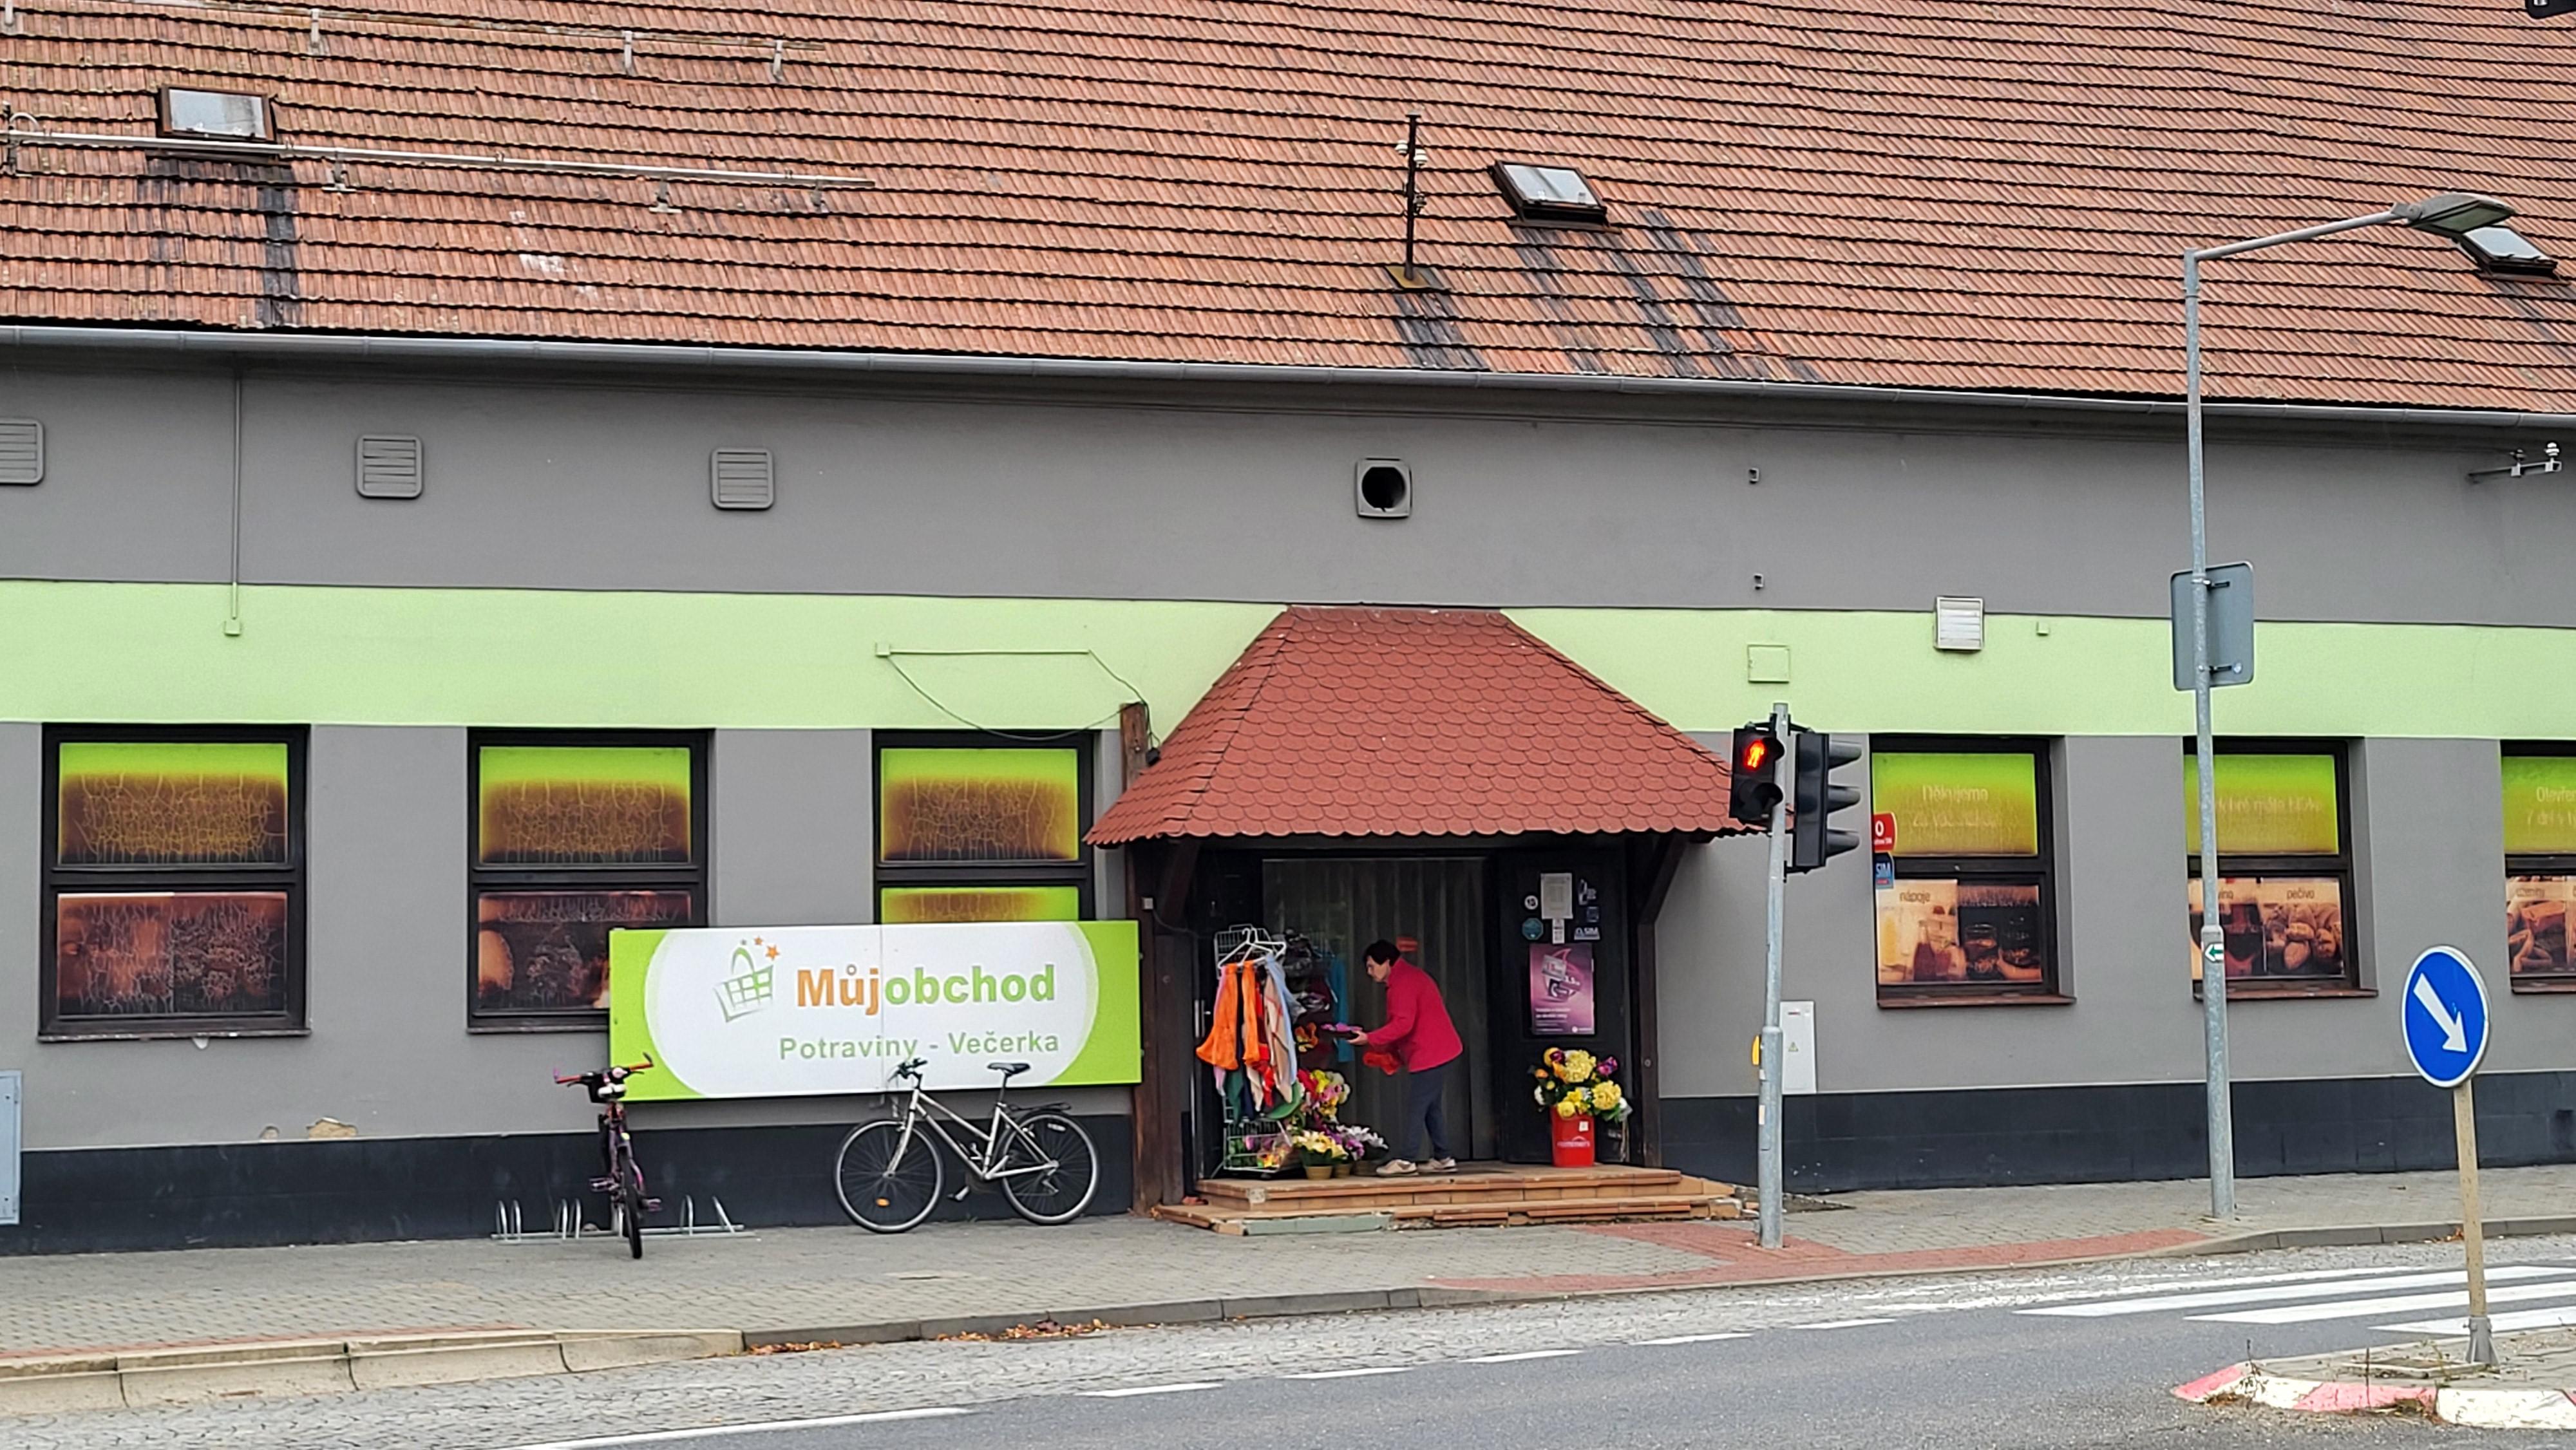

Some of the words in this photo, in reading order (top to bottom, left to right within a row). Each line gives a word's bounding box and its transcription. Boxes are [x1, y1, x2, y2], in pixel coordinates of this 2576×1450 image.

[2287, 887, 2315, 899] pečivo
[797, 964, 1054, 1015] Můjobchod
[780, 1035, 918, 1060] Potraviny
[948, 1030, 1059, 1055] Večerka
